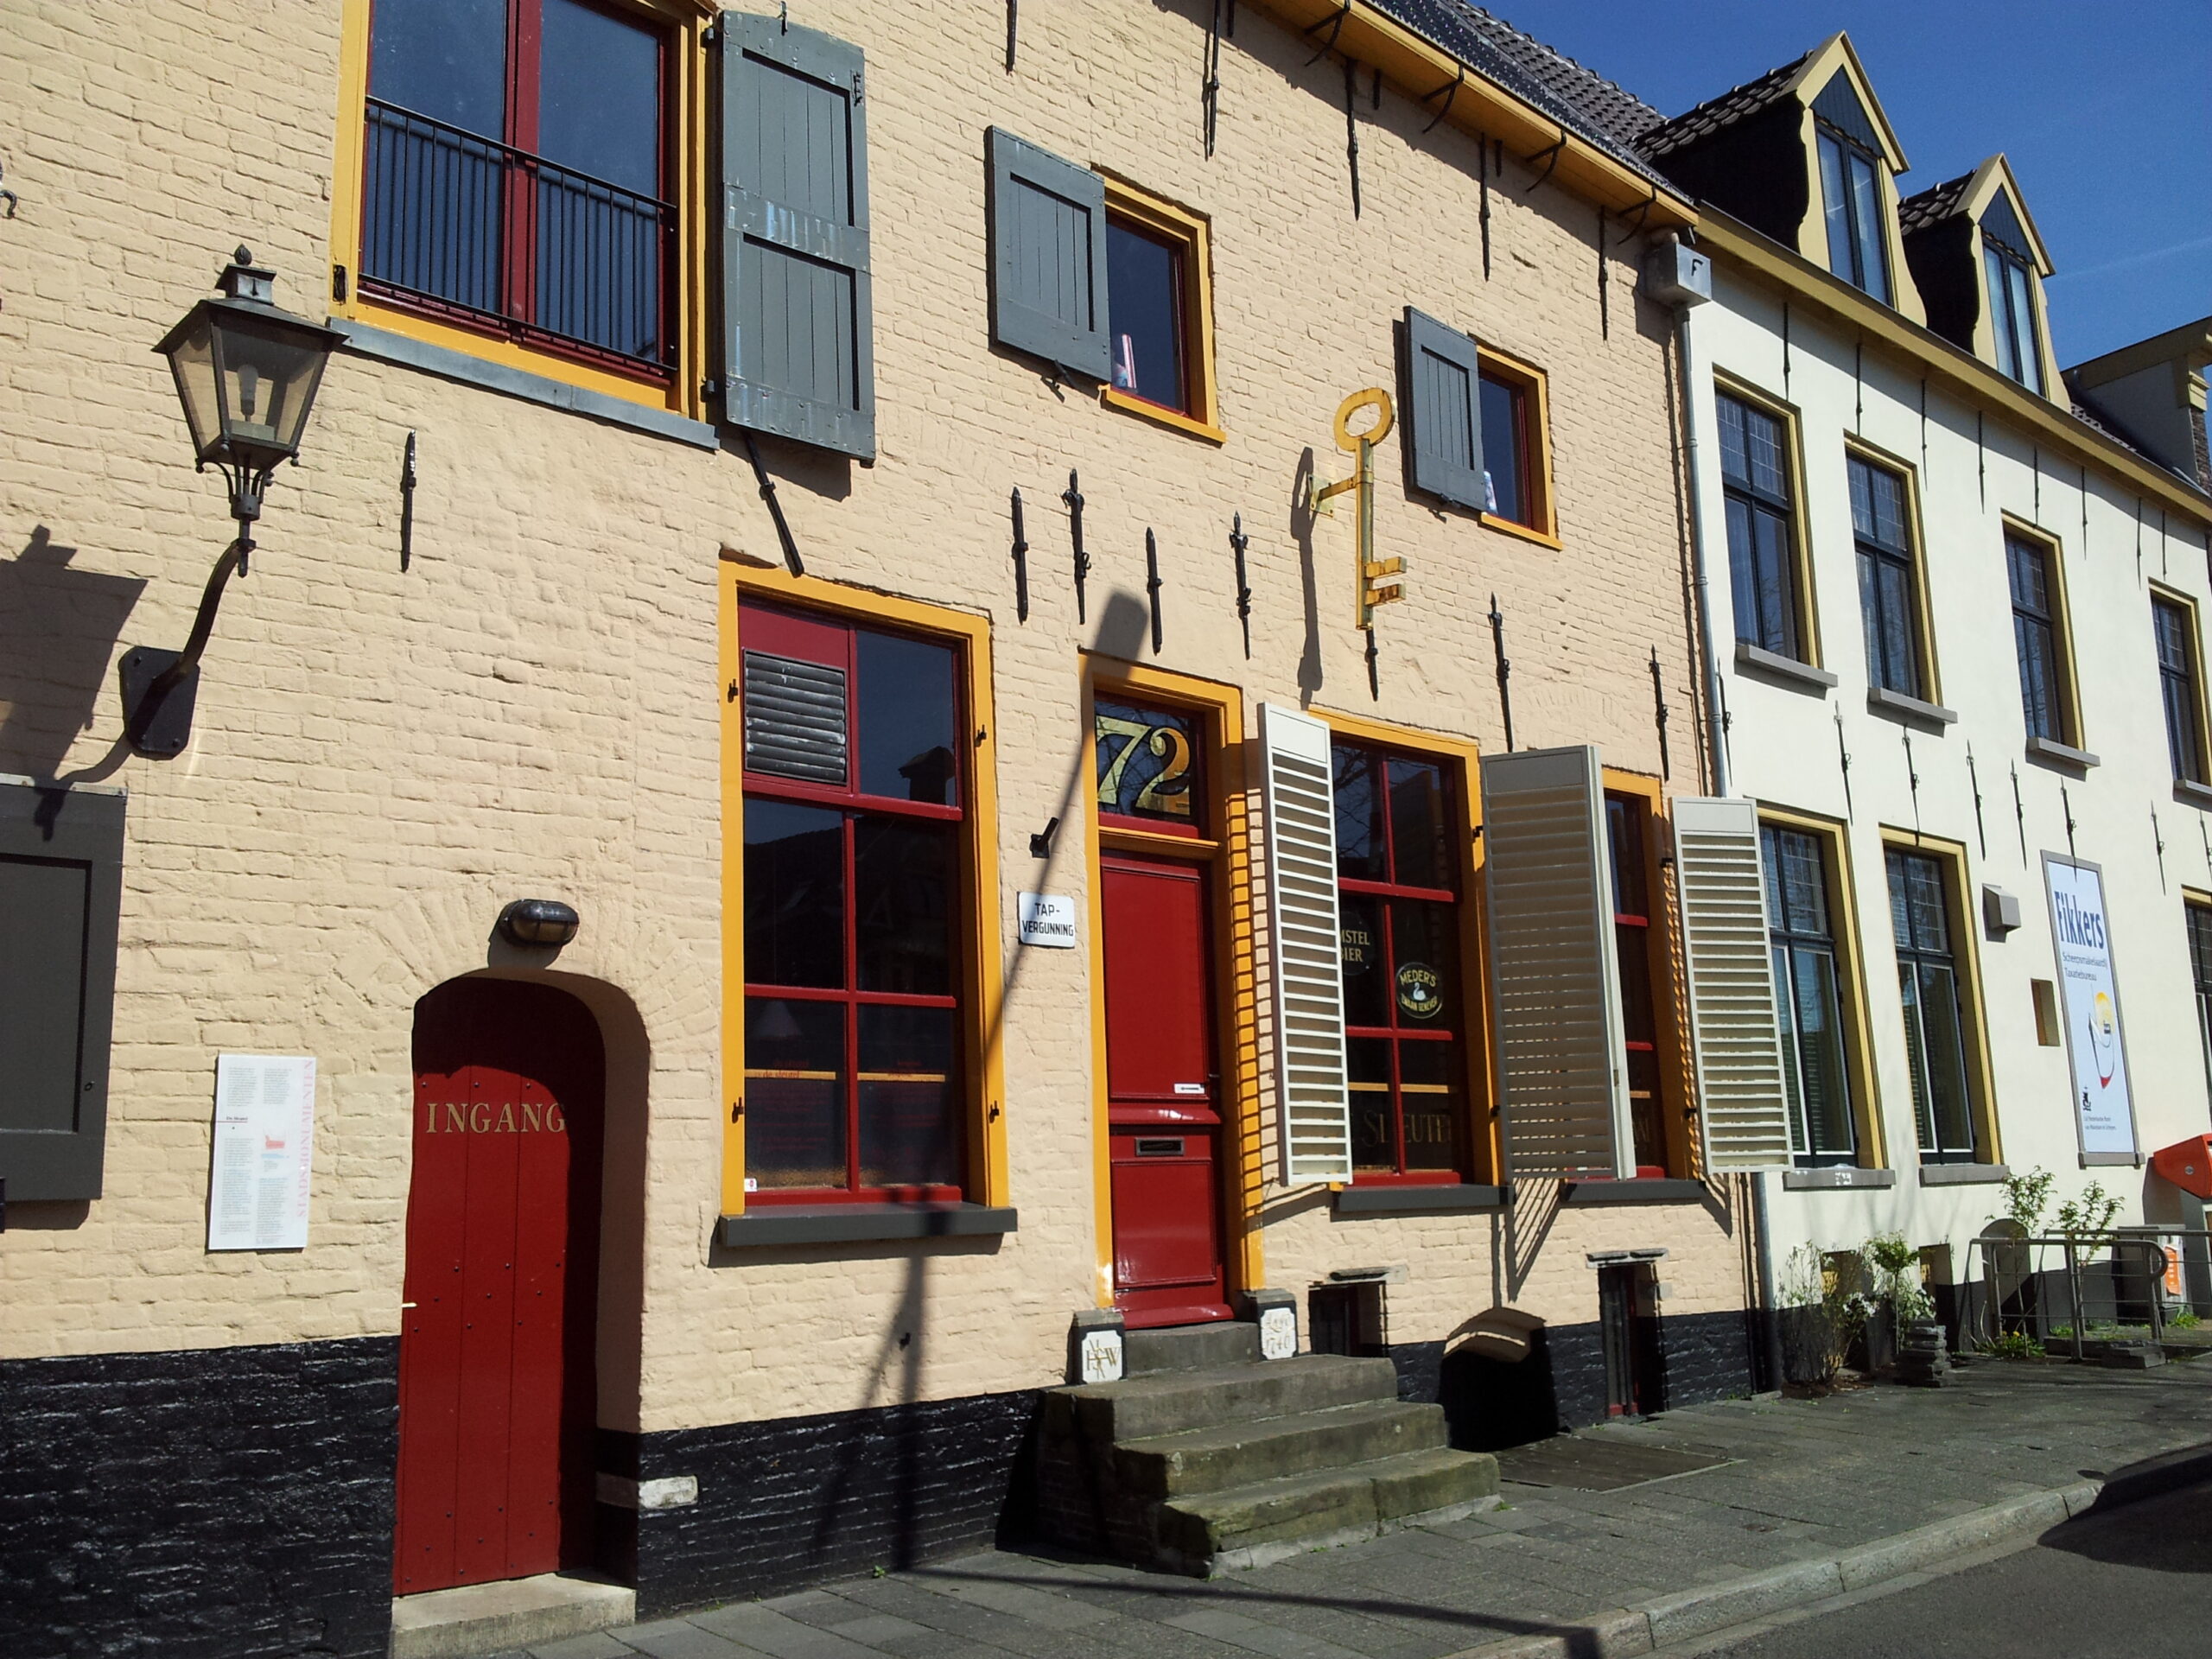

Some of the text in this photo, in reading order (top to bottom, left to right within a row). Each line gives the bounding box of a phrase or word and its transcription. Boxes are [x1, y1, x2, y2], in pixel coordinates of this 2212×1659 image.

[1095, 715, 1191, 817] 72
[1034, 902, 1060, 917] TAP-
[2054, 891, 2105, 950] Fikkers
[1022, 920, 1074, 938] VERGUNNING
[426, 1103, 566, 1134] INGANG
